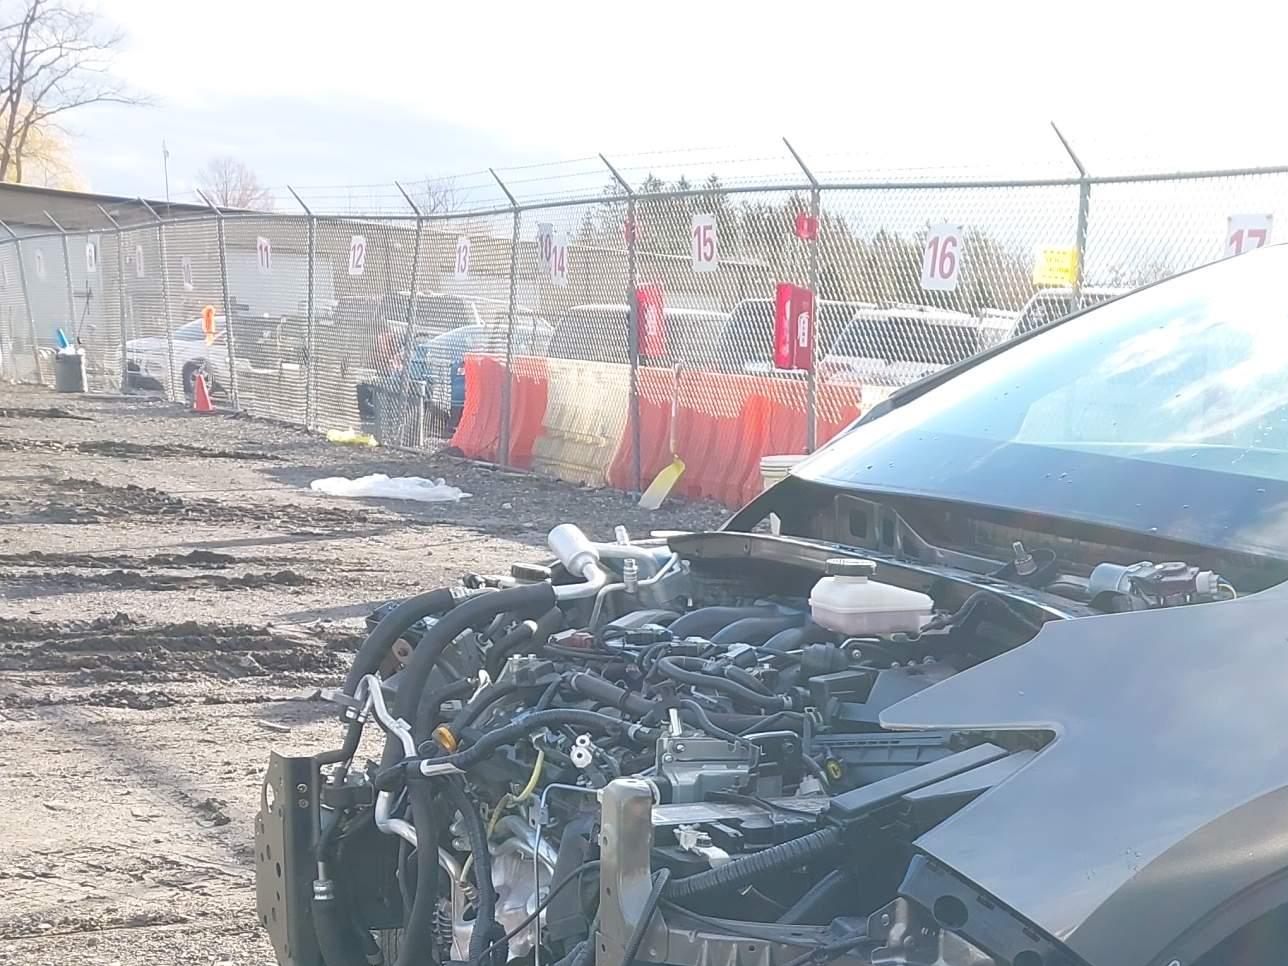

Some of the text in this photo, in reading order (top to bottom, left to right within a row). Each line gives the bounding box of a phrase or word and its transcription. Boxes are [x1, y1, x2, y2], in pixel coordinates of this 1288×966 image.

[258, 243, 269, 269] 11
[351, 243, 364, 269] 12
[693, 224, 715, 262] 15
[928, 235, 957, 279] 16
[1229, 228, 1267, 256] 17
[455, 243, 468, 274] 13
[552, 245, 565, 278] 14
